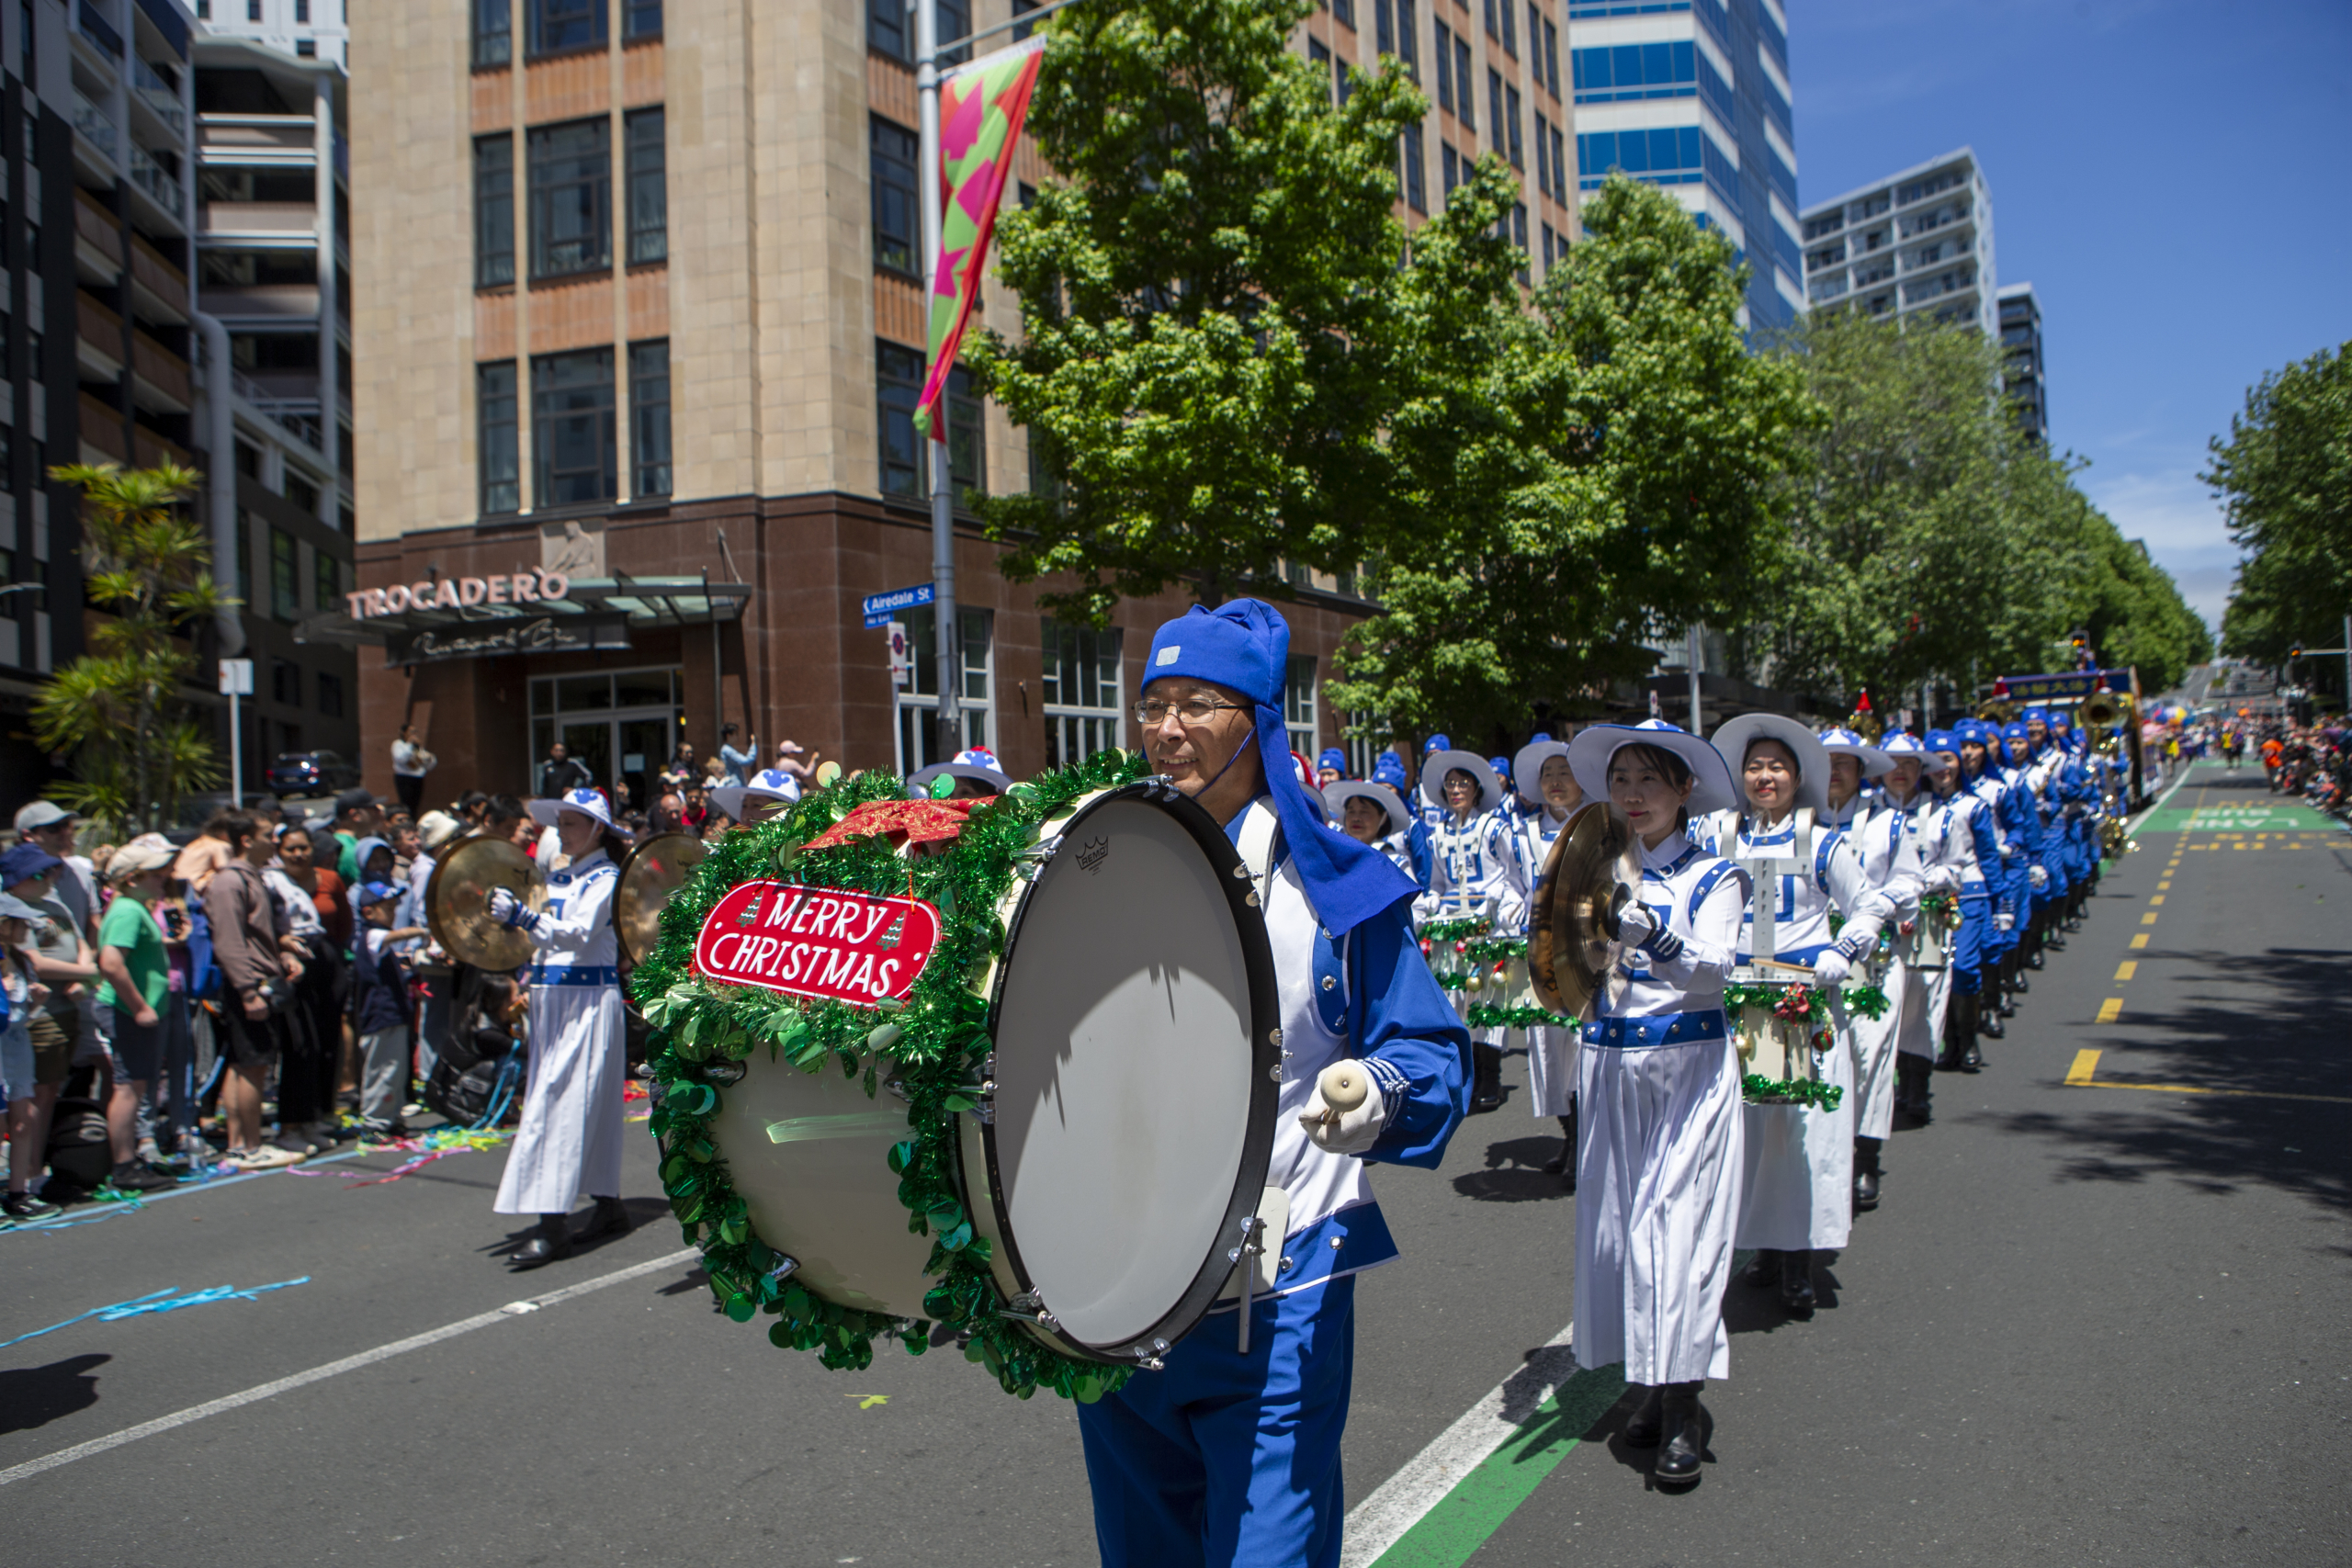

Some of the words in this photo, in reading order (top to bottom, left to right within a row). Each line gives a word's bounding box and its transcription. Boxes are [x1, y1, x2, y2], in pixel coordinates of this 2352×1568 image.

[872, 592, 914, 610] Airedale
[917, 587, 930, 601] St
[2177, 818, 2300, 829] LANE
[1081, 846, 1106, 866] REMO
[763, 892, 888, 944] MERRY
[708, 932, 899, 998] CHRISTMAS
